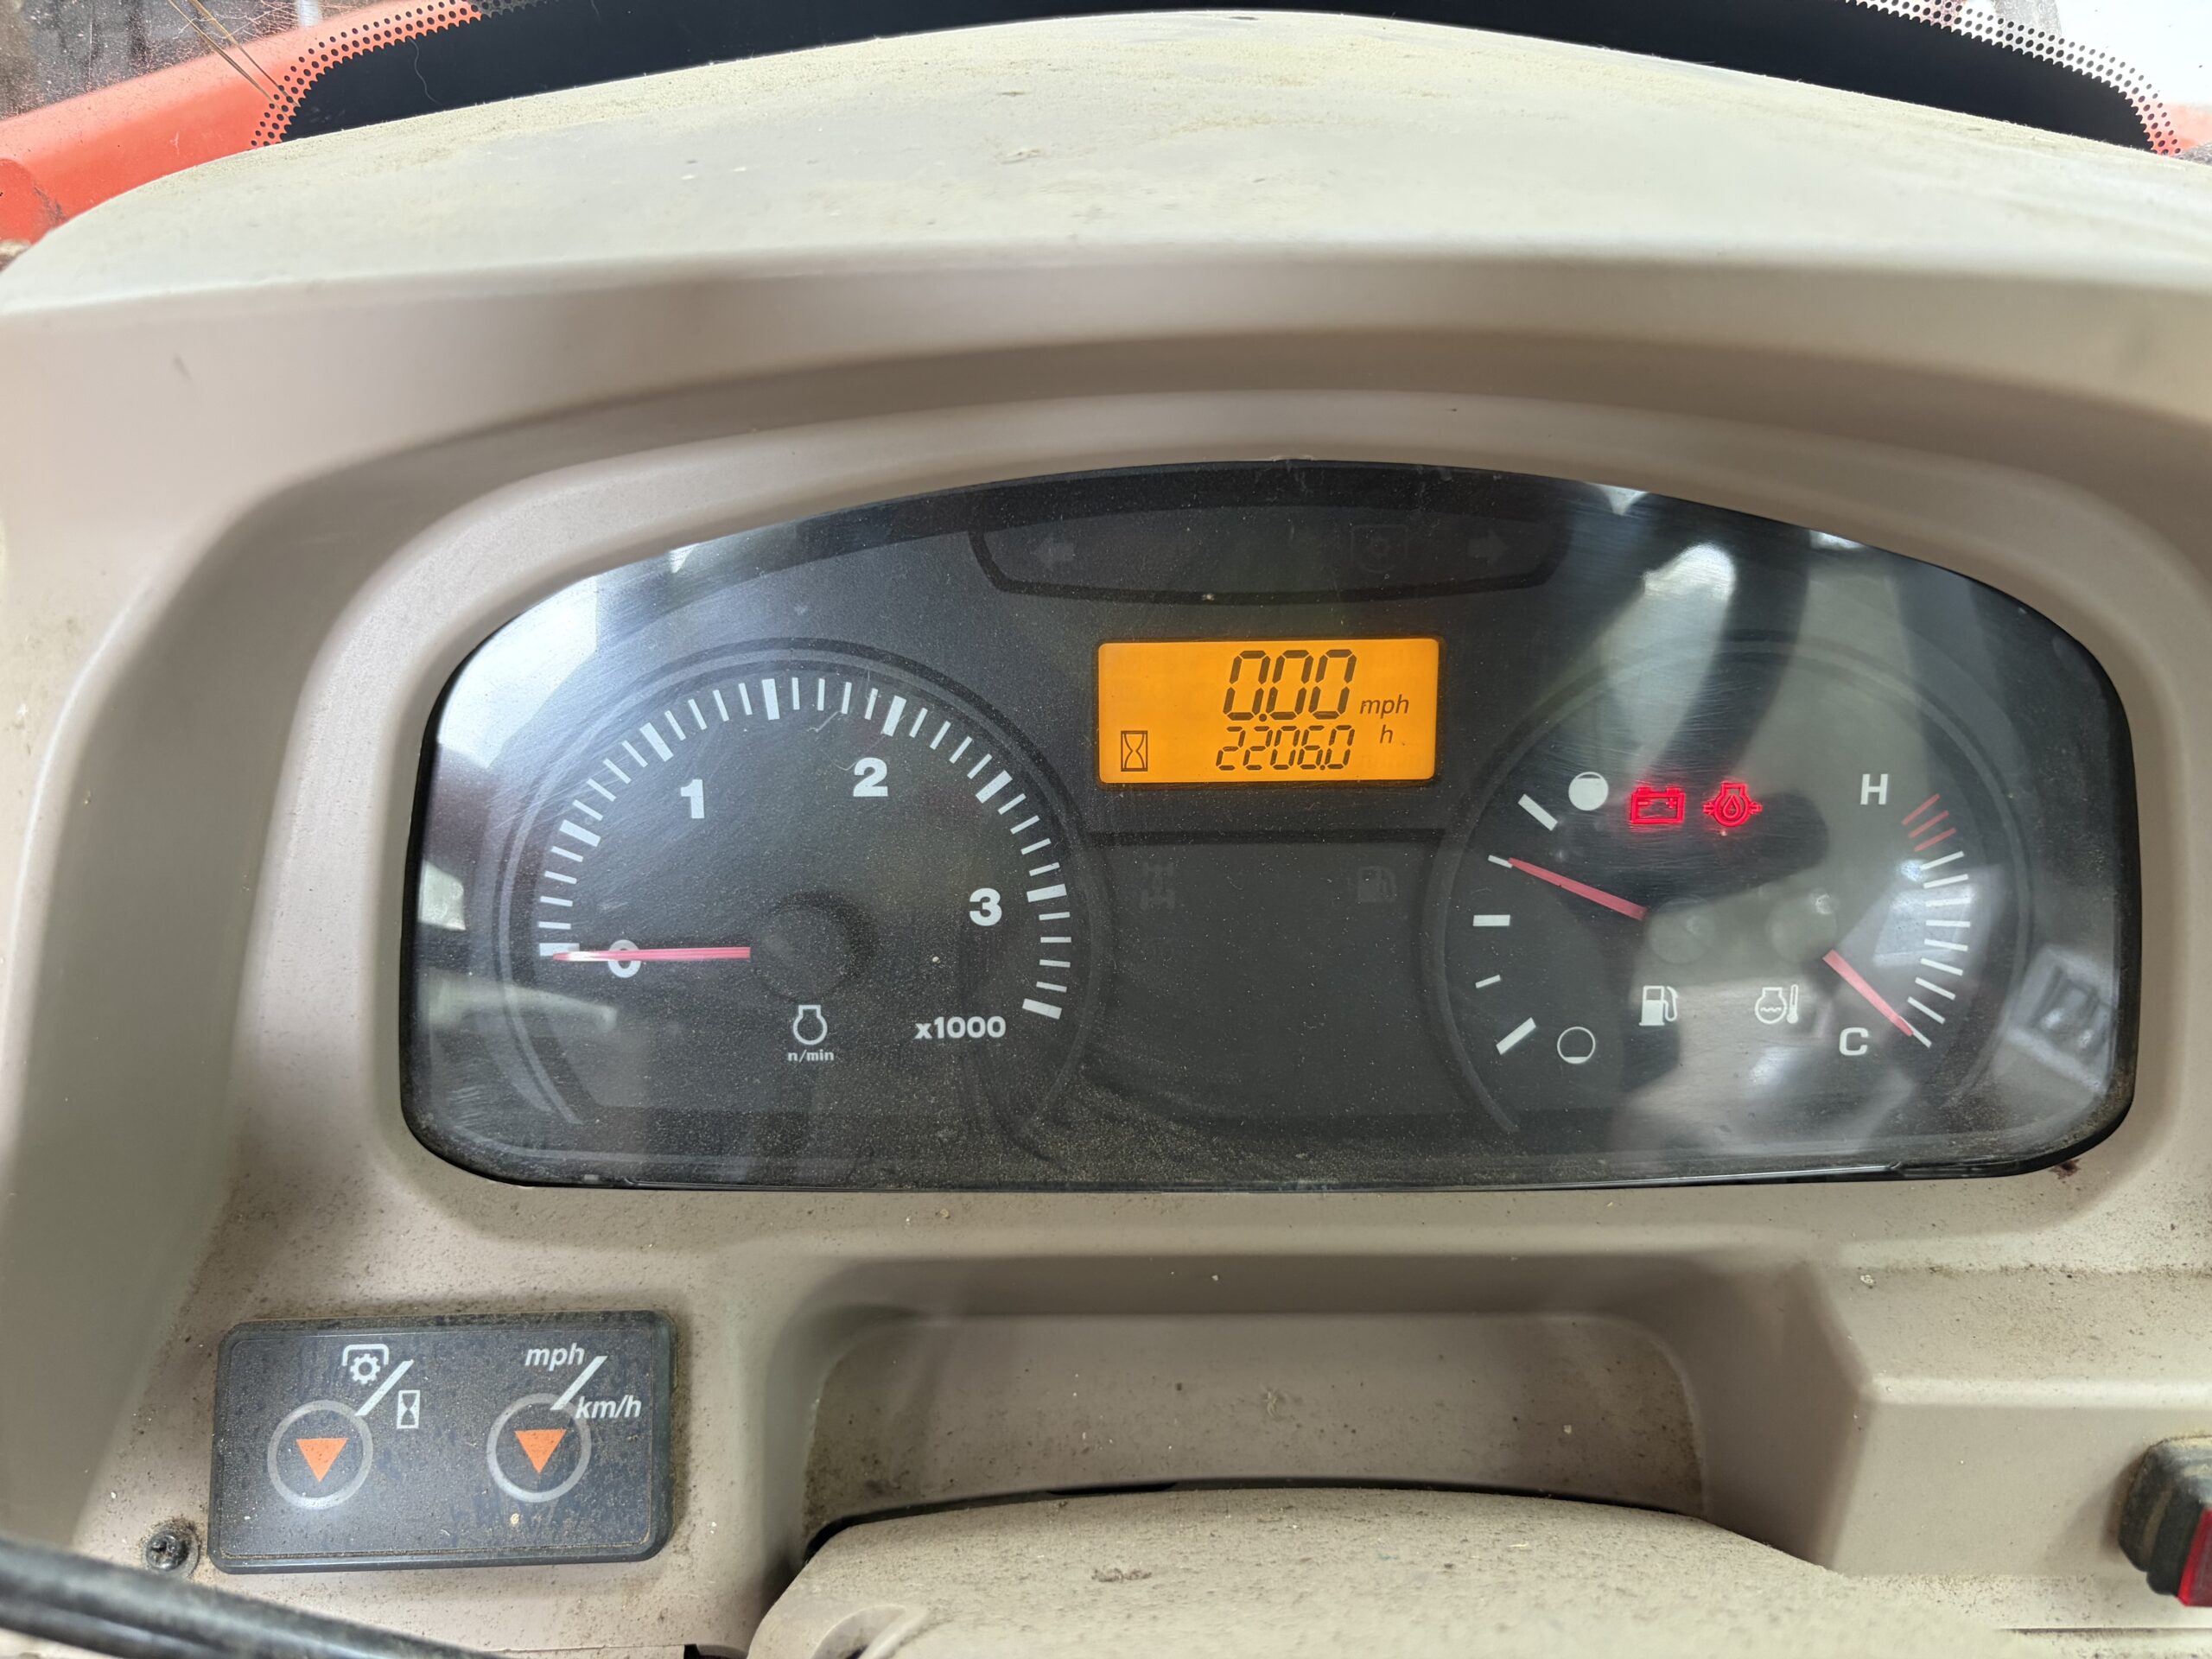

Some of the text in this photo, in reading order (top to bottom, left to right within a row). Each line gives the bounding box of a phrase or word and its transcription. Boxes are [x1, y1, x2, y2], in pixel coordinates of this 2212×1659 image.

[1359, 695, 1409, 718] mph
[1380, 724, 1393, 744] h
[852, 758, 888, 797] 2
[1860, 773, 1889, 805] H
[680, 779, 704, 818] 1
[969, 888, 1002, 926] 3
[915, 1015, 1006, 1039] x1000
[1839, 1027, 1869, 1056] C
[787, 1049, 834, 1063] n/min
[524, 1343, 585, 1372] mph
[575, 1395, 641, 1419] km/h
